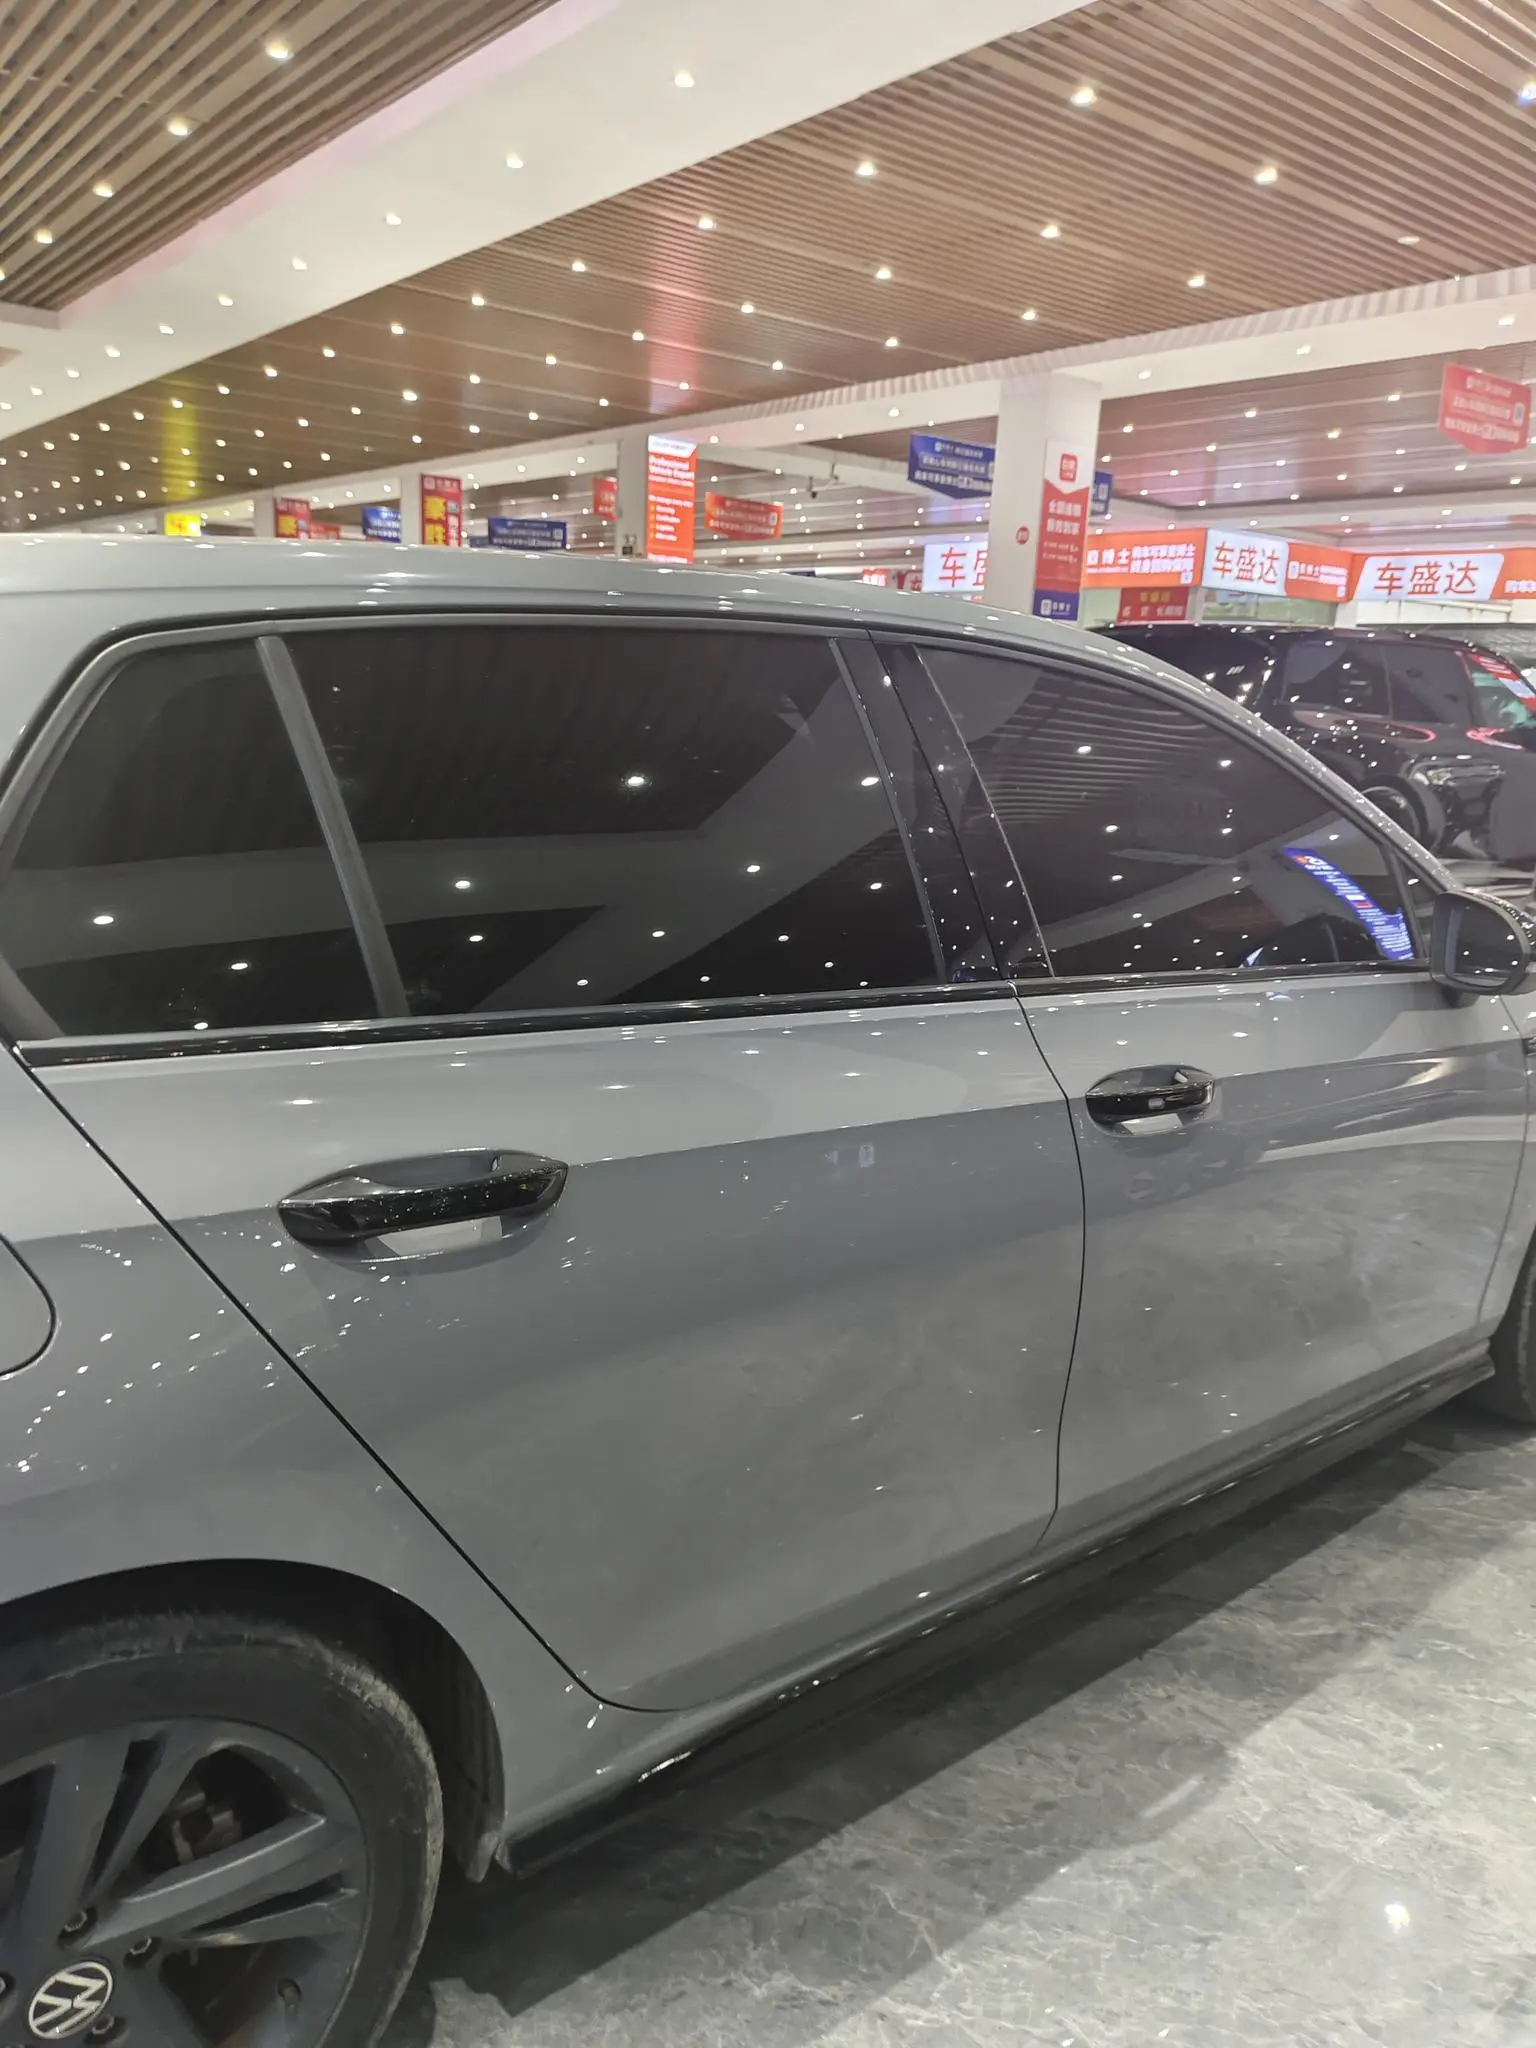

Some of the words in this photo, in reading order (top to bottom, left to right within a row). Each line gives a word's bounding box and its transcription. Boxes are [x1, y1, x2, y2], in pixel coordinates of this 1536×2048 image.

[1212, 540, 1280, 585] 车盛达
[1373, 561, 1479, 596] 车盛达
